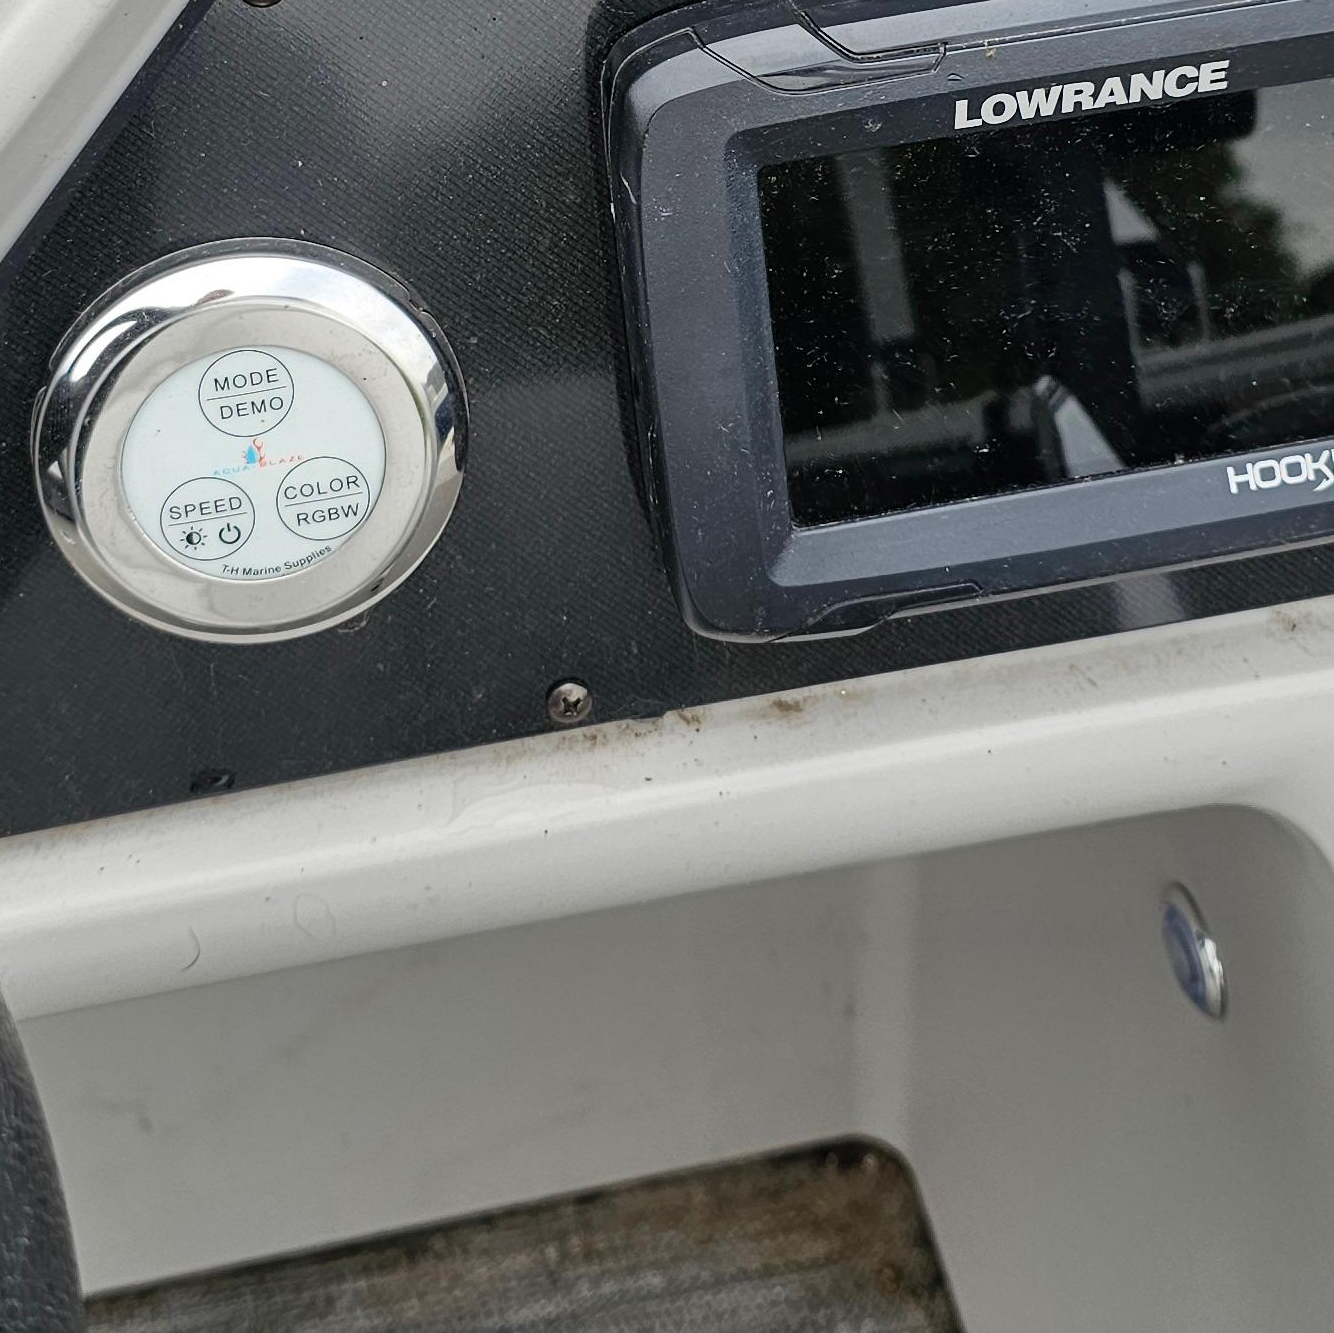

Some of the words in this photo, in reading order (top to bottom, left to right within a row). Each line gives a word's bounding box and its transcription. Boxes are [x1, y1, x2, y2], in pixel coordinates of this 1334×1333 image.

[954, 60, 1230, 130] LOWRANCE
[214, 368, 279, 392] MODE
[220, 396, 284, 420] DEMO
[284, 475, 360, 500] COLOR
[169, 496, 243, 520] SPEED
[296, 502, 360, 526] RGBW
[222, 564, 240, 575] T-H
[242, 566, 282, 576] Marine
[284, 545, 332, 570] Supplies
